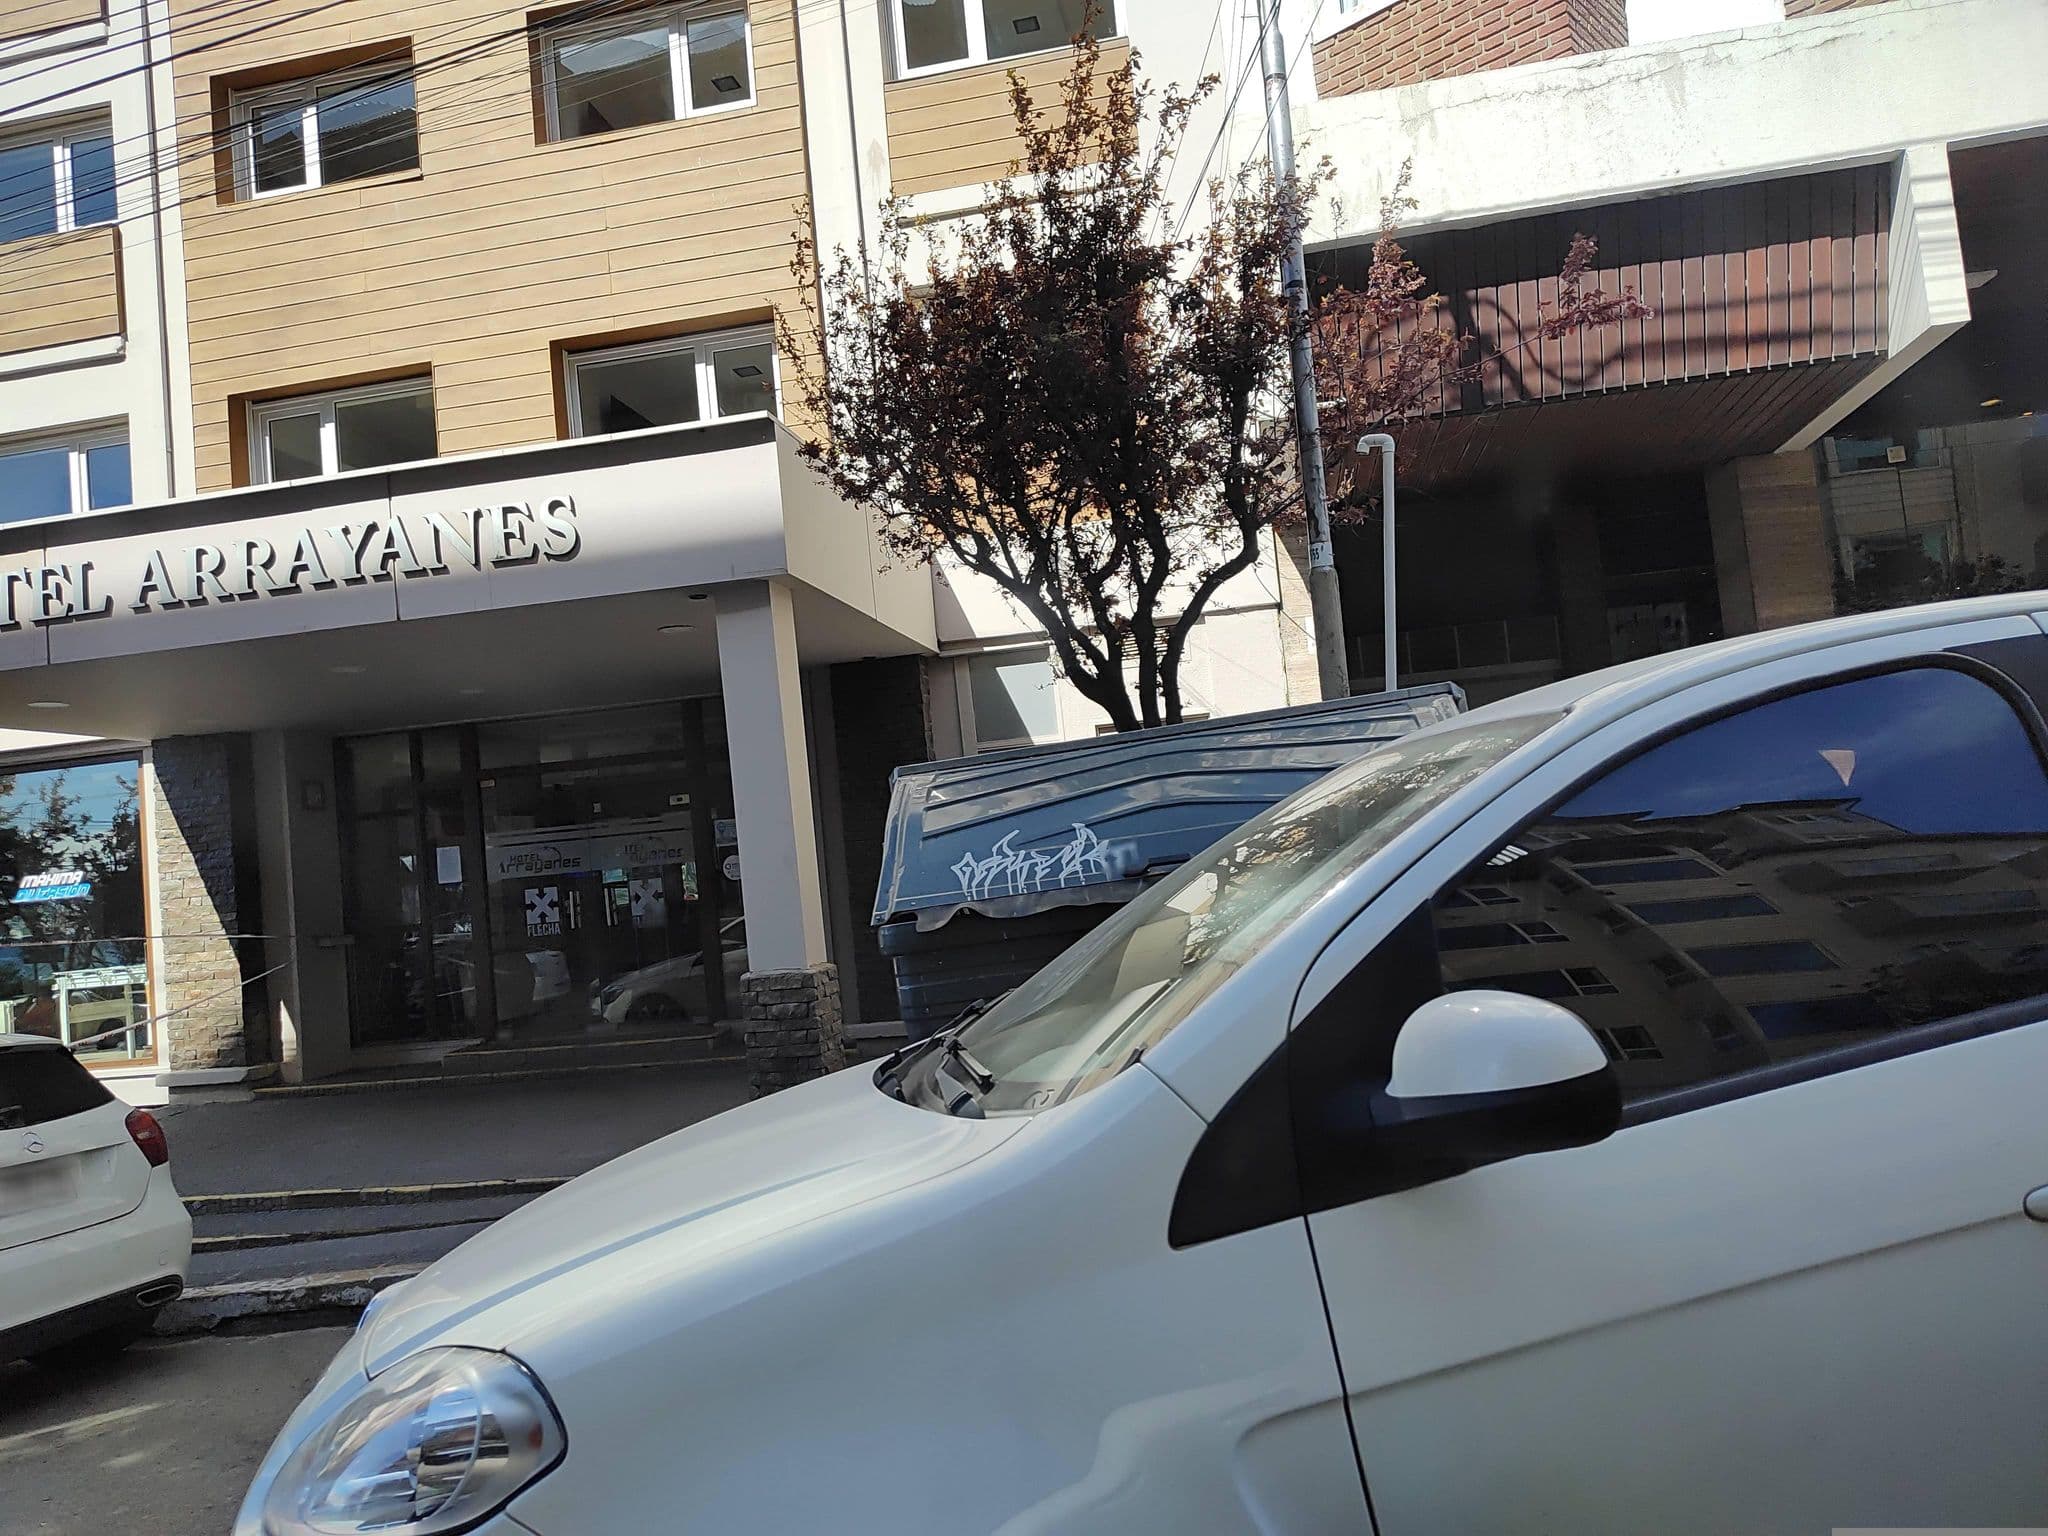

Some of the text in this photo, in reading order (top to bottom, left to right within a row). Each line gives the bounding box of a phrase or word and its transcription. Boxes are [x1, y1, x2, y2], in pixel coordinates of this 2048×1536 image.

[130, 495, 580, 613] ARRAYANES
[498, 857, 582, 873] Arrayanes
[510, 853, 541, 864] HOTEL
[527, 922, 561, 937] FLECHA
